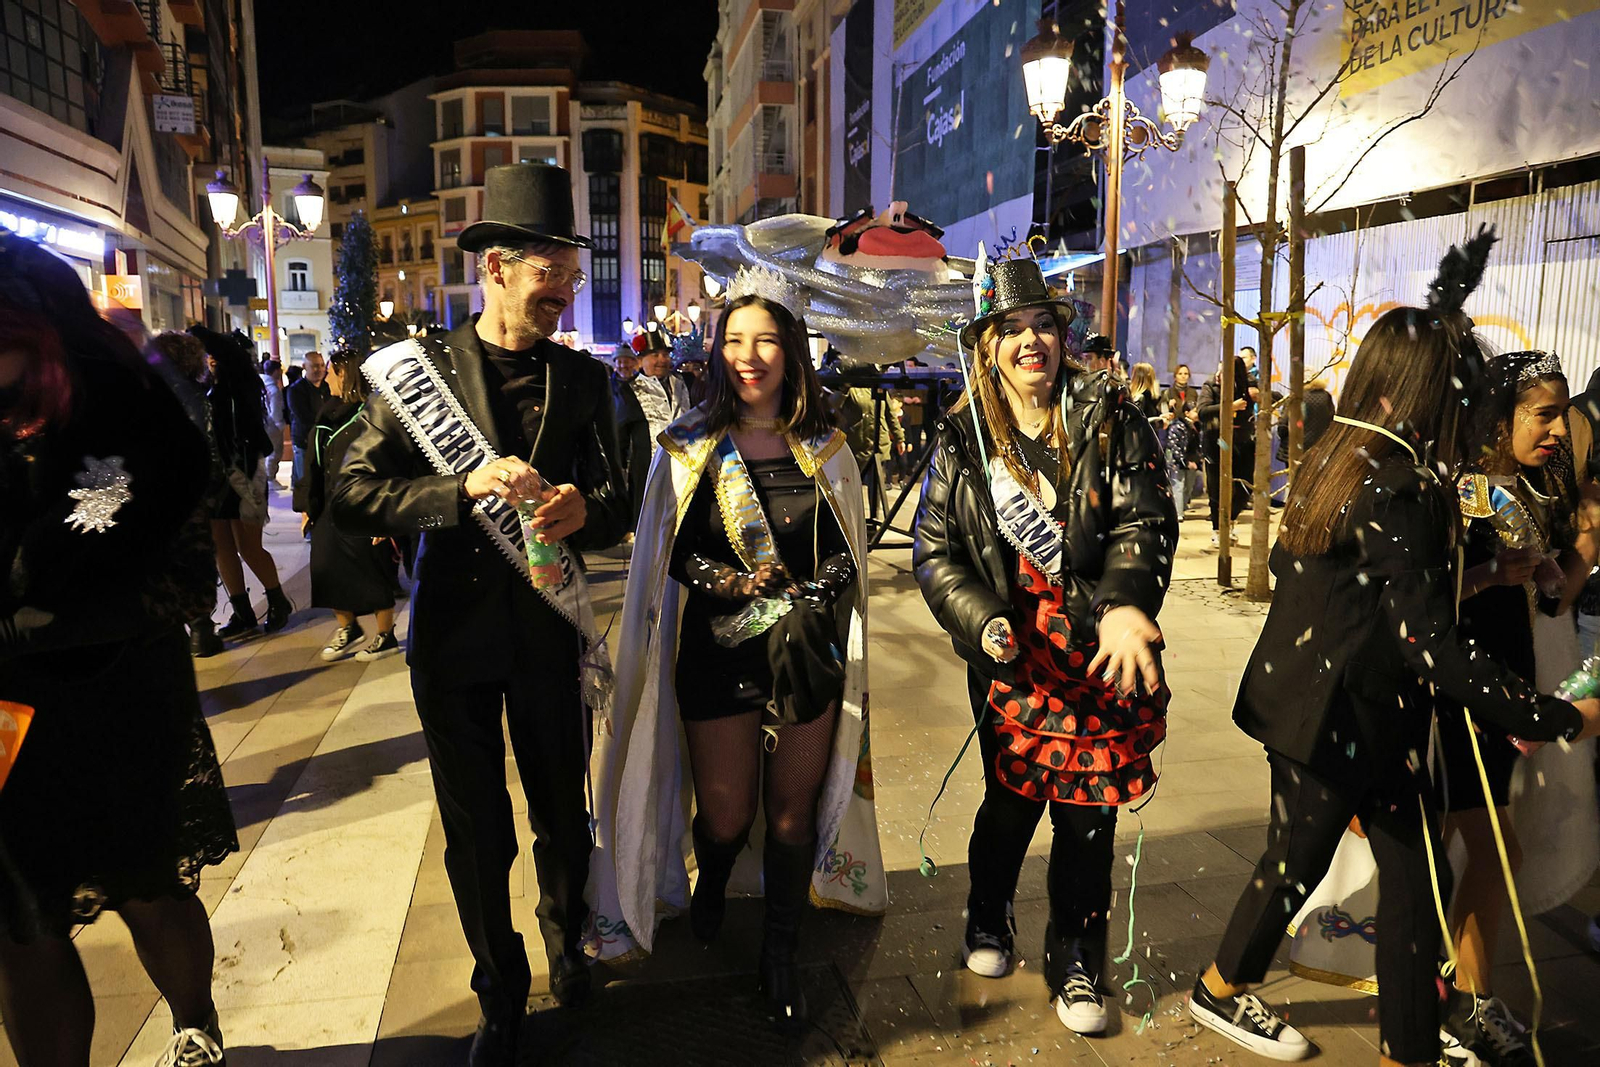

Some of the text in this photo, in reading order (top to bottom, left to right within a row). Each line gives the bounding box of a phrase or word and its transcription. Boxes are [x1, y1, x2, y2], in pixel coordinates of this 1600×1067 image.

[1351, 0, 1430, 42] PARA EL
[927, 41, 965, 86] Fundación
[1350, 44, 1375, 75] DE
[1379, 35, 1402, 64] LA
[927, 90, 964, 148] Cajasol
[997, 491, 1062, 566] DAMA
